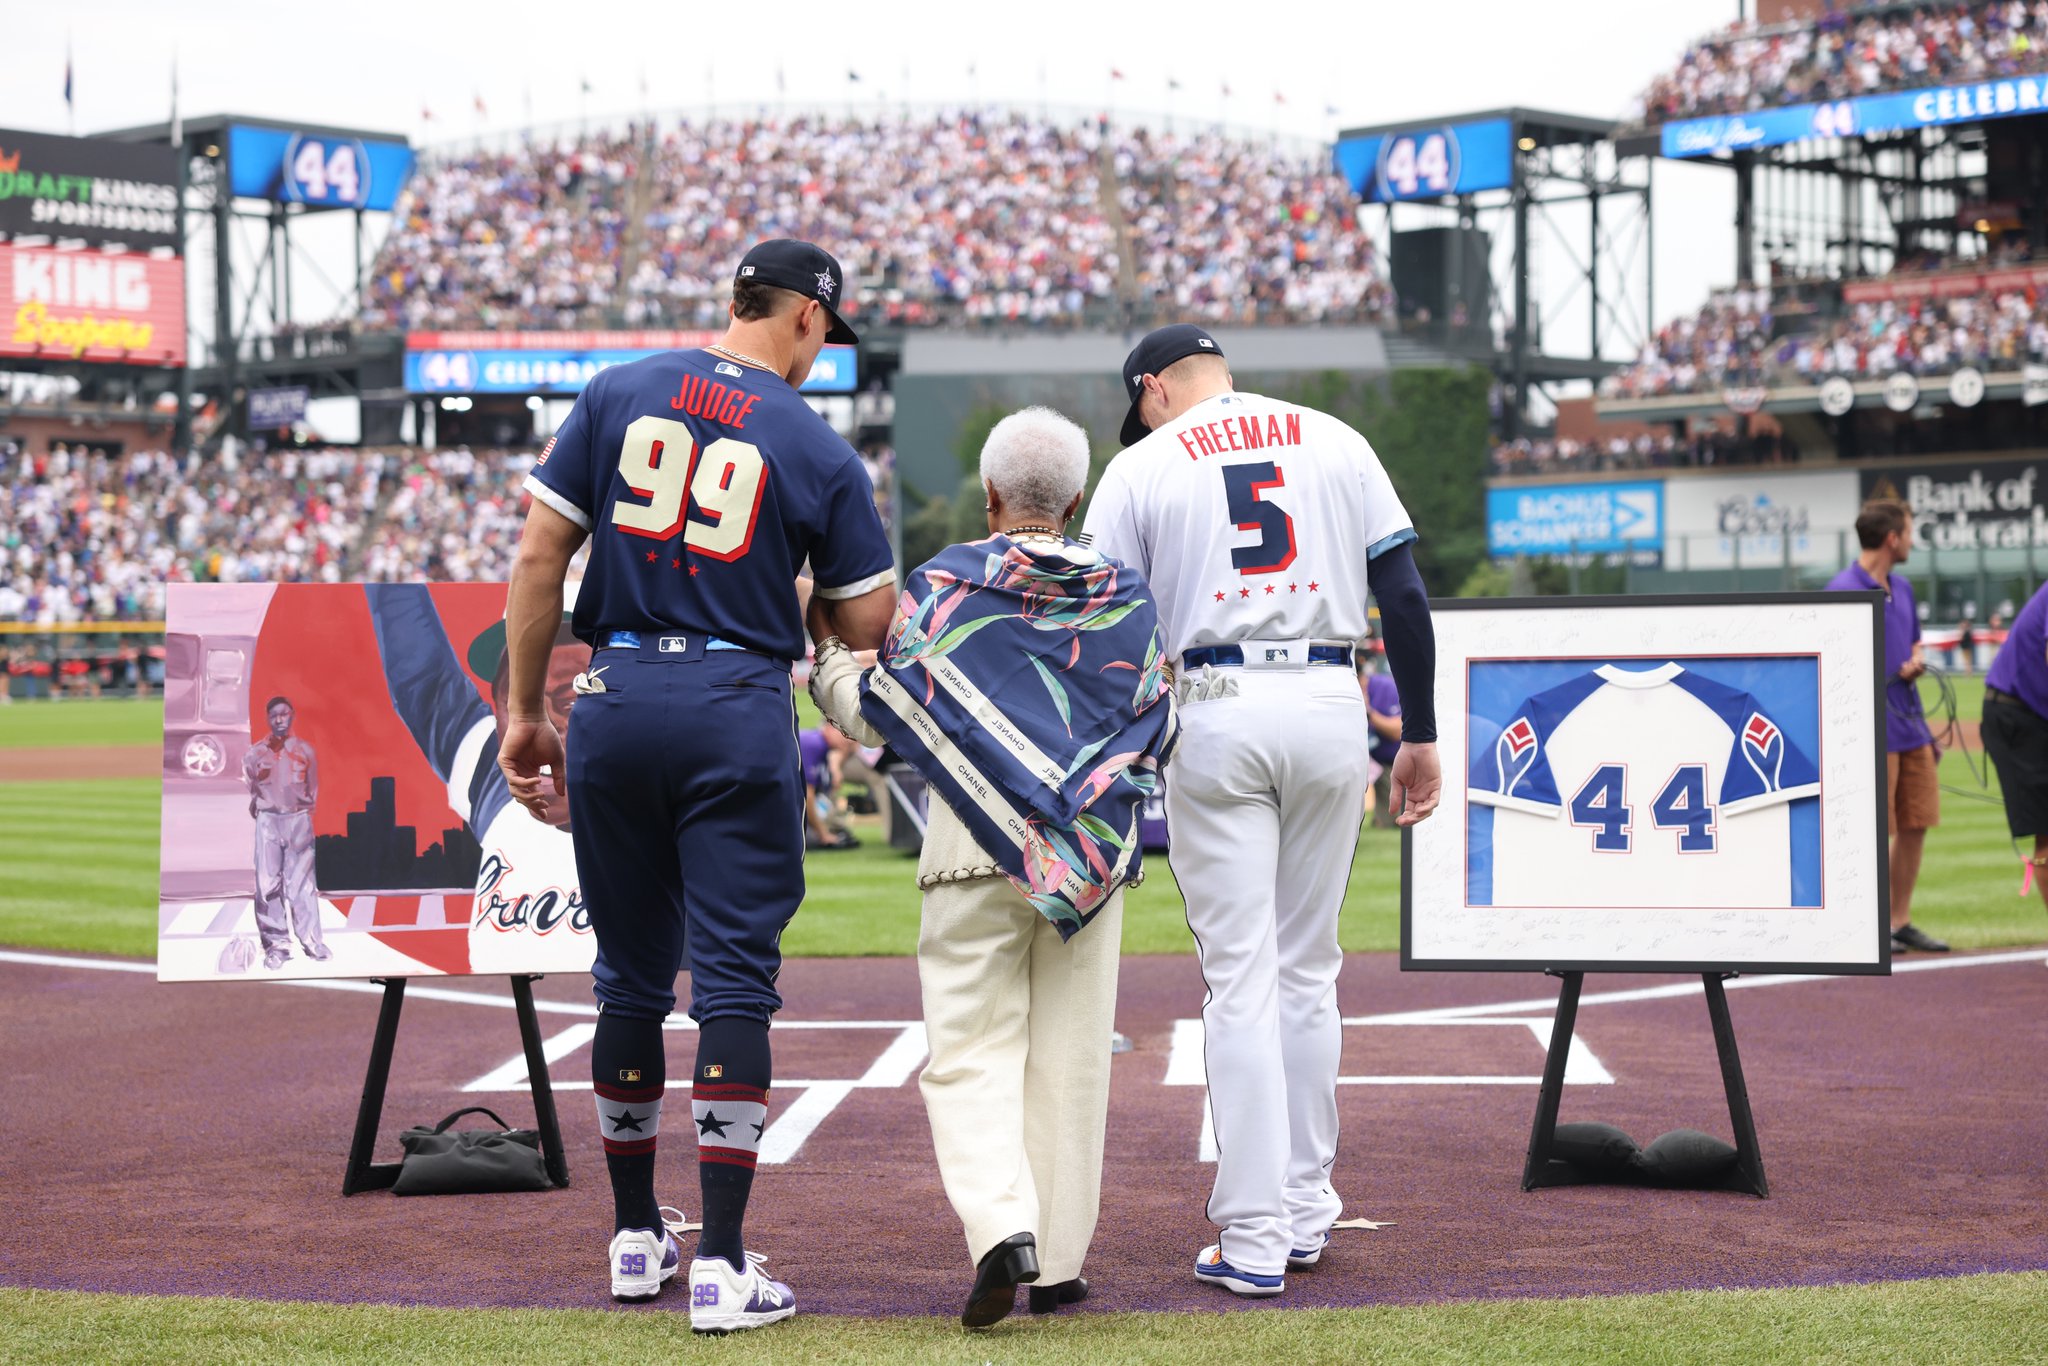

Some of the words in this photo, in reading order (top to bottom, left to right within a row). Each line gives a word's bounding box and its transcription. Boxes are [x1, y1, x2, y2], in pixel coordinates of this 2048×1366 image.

[1913, 77, 2048, 122] CELEBR
[294, 140, 359, 200] 44
[1387, 133, 1449, 194] 44
[12, 252, 151, 312] KING
[424, 353, 470, 387] 44
[671, 373, 763, 429] JUDGE
[1177, 413, 1301, 461] FREEMAN
[611, 415, 769, 563] 99
[1221, 460, 1298, 576] 5
[1908, 470, 1993, 513] Bank
[1997, 467, 2037, 511] of
[912, 712, 939, 746] CHANEL
[958, 764, 988, 800] CHANEL
[1064, 876, 1082, 895] HAN
[1568, 762, 1718, 855] 44
[619, 1253, 646, 1275] 99
[692, 1283, 719, 1306] 99
